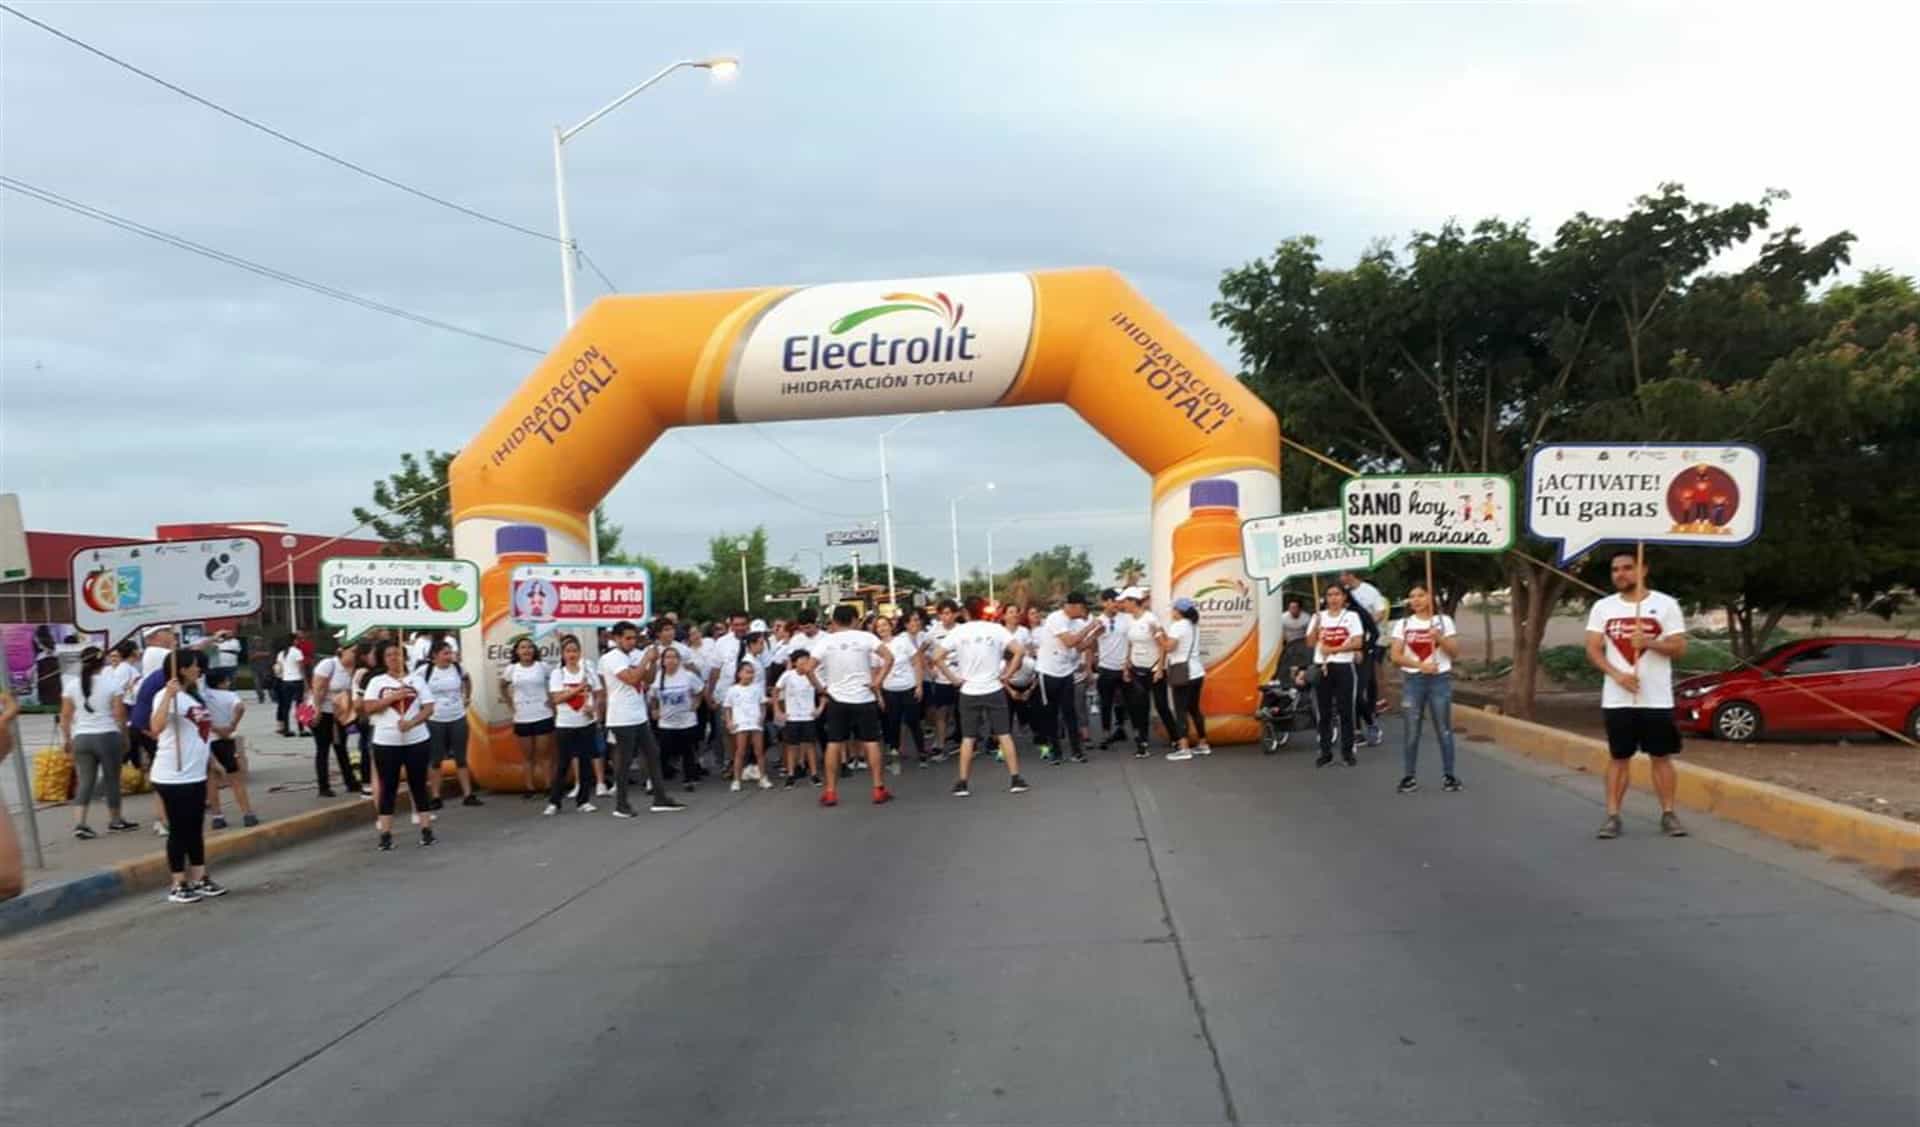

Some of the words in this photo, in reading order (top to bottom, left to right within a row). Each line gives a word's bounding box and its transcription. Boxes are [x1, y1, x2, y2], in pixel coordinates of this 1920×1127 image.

[783, 326, 977, 372] Electrolit
[913, 370, 974, 387] TOTAL!
[534, 355, 618, 445] TOTAL!
[1134, 354, 1225, 435] TOTAL!
[1537, 473, 1661, 494] ¡ACTIVATE!
[1349, 492, 1400, 516] SANO
[1536, 495, 1569, 517] Tú
[1577, 500, 1659, 522] ganas
[1283, 533, 1323, 548] Bebe
[1350, 523, 1402, 545] SANO
[1409, 525, 1491, 546] mañana
[329, 573, 375, 587] ¡Todos
[377, 576, 422, 586] somos
[332, 588, 420, 609] Salud!
